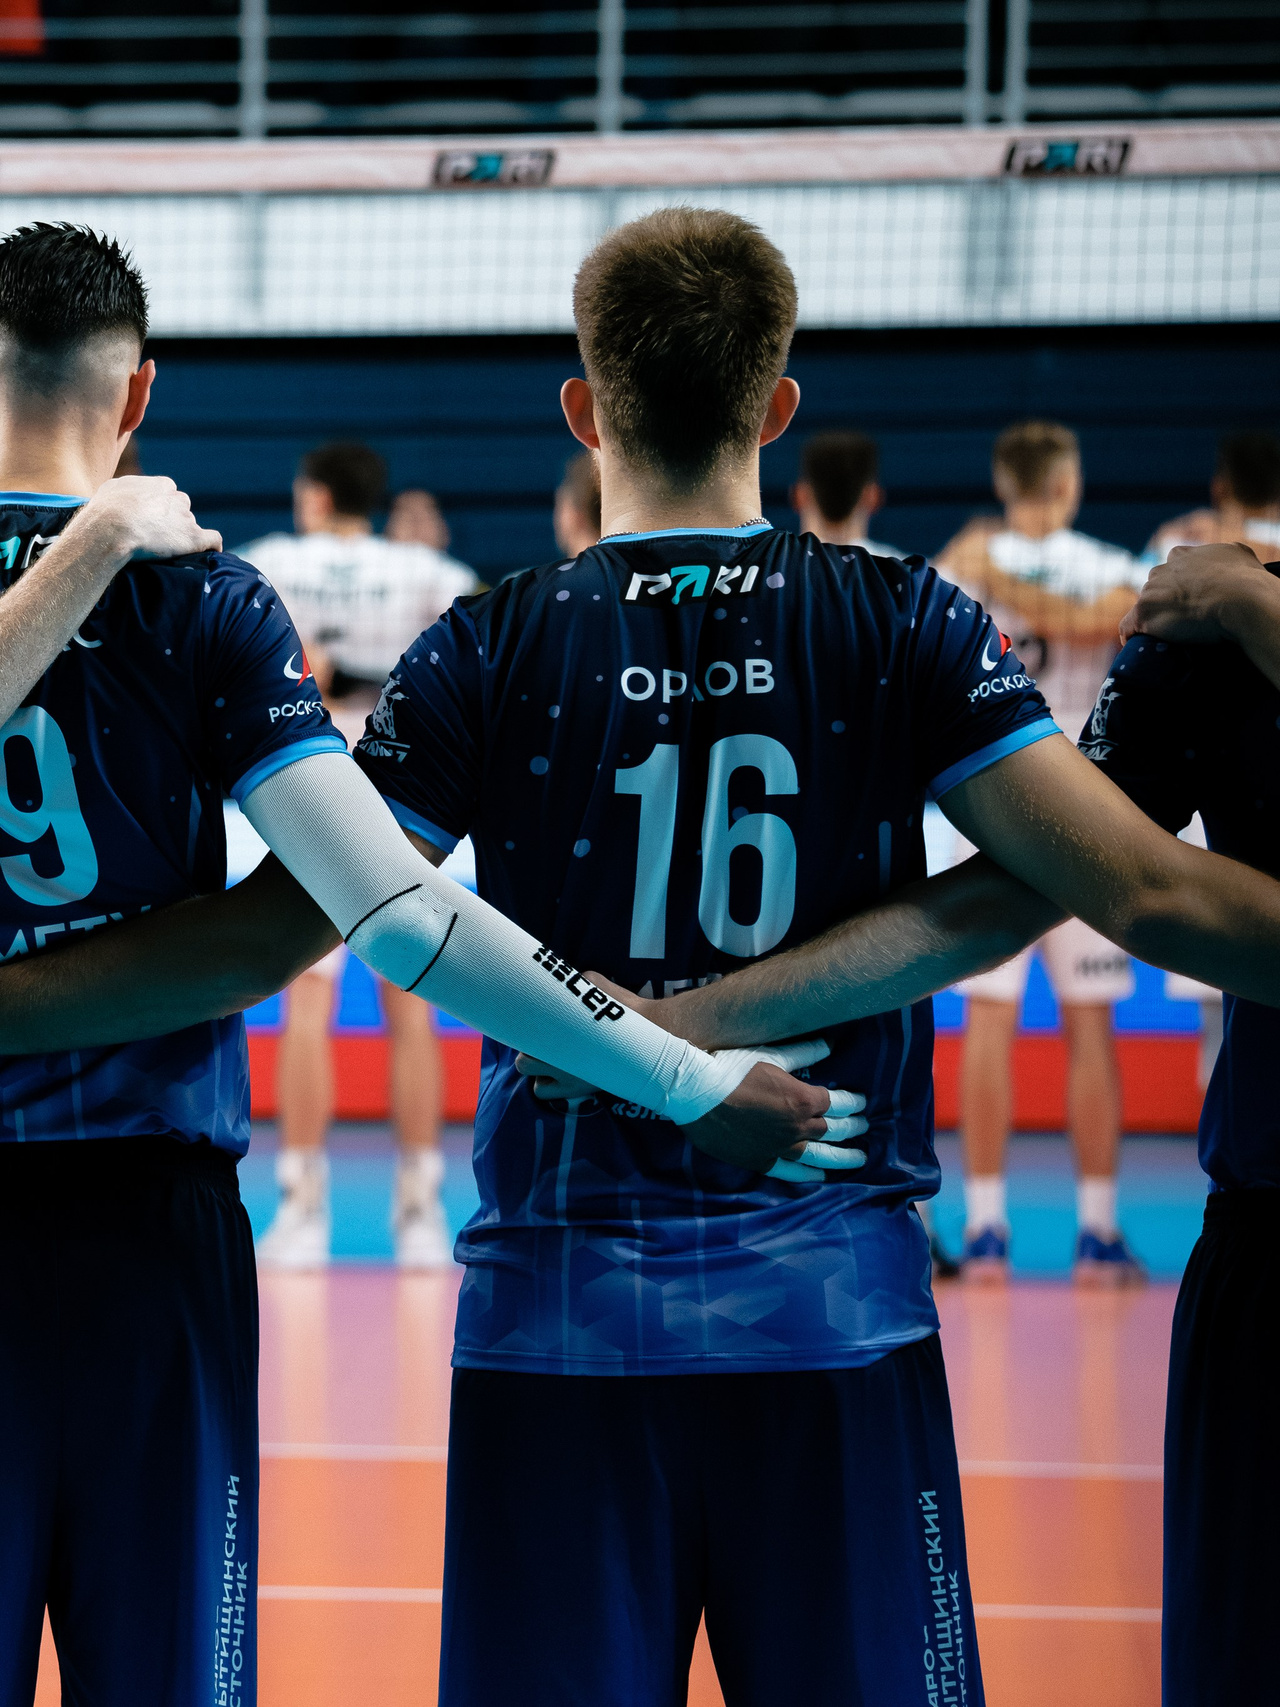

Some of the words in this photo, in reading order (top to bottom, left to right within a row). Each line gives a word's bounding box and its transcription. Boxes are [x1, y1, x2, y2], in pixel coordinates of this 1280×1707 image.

[625, 564, 760, 605] PARI
[613, 733, 799, 959] 16
[948, 1569, 967, 1707] ТОЧНИК
